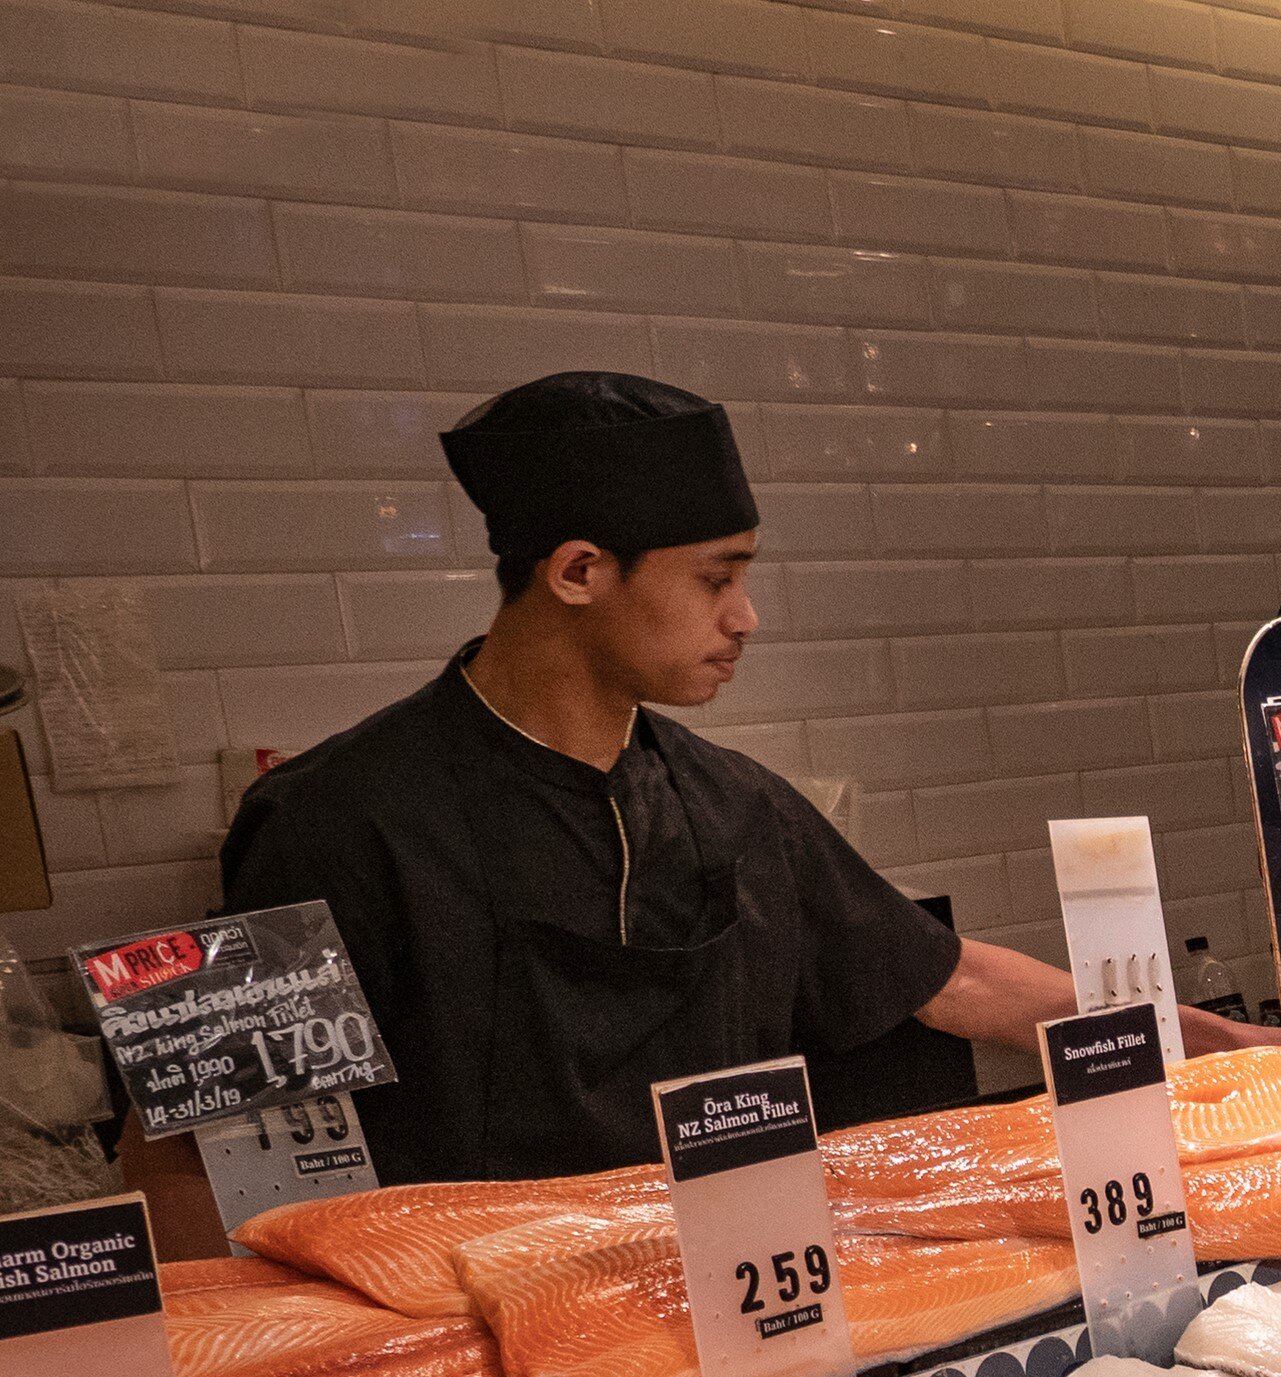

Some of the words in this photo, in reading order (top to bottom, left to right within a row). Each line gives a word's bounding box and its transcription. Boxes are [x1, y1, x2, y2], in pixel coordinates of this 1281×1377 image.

[92, 953, 123, 987] M
[124, 938, 187, 977] PRICE
[199, 1013, 267, 1048] Salmon
[1063, 1039, 1116, 1061] Snowfish
[1117, 1032, 1147, 1050] Fillet
[250, 1011, 376, 1088] 1,790
[187, 1055, 236, 1087] 1,990
[677, 1121, 702, 1140] NZ
[704, 1110, 760, 1134] Salmon
[762, 1100, 800, 1122] Fillet
[704, 1097, 732, 1117] Ōra
[734, 1092, 769, 1112] King
[299, 1155, 326, 1170] Baht
[353, 1150, 363, 1162] G
[1080, 1172, 1154, 1236] 389
[1139, 1221, 1158, 1235] Baht
[1162, 1217, 1176, 1231] 100
[0, 1248, 47, 1269] arm
[51, 1233, 137, 1261] Organic
[0, 1269, 32, 1290] ish
[35, 1259, 118, 1284] Salmon
[735, 1243, 831, 1315] 259
[762, 1318, 787, 1334] Baht
[792, 1310, 810, 1326] 100
[810, 1307, 820, 1320] G
